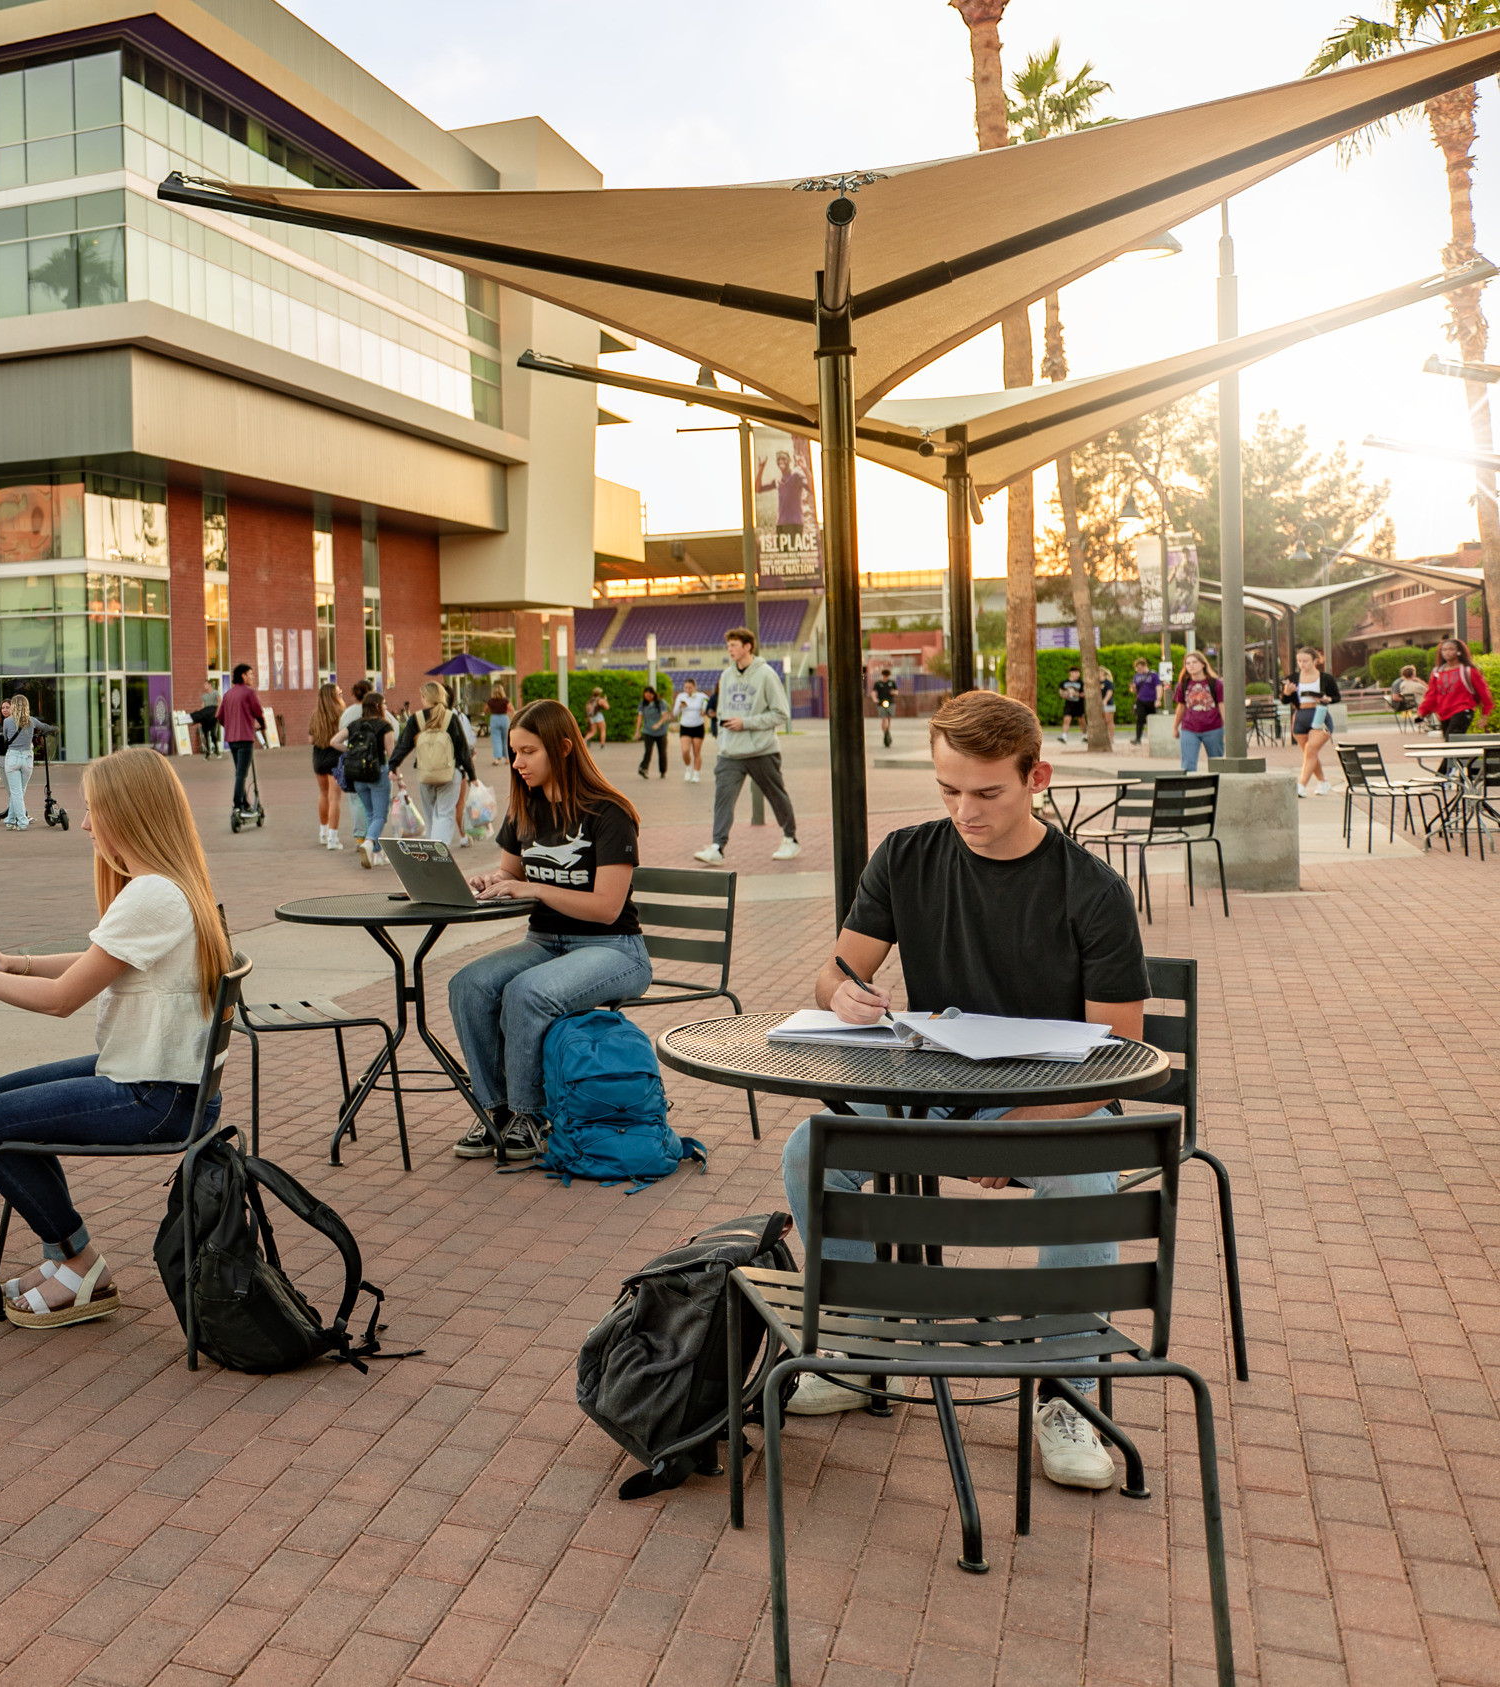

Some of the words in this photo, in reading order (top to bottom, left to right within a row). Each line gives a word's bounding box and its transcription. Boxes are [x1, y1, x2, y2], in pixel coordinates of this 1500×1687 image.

[759, 533, 779, 552] 1ST
[780, 532, 818, 552] PLACE
[760, 566, 770, 576] IN
[771, 565, 785, 576] THE
[524, 864, 589, 886] OPES
